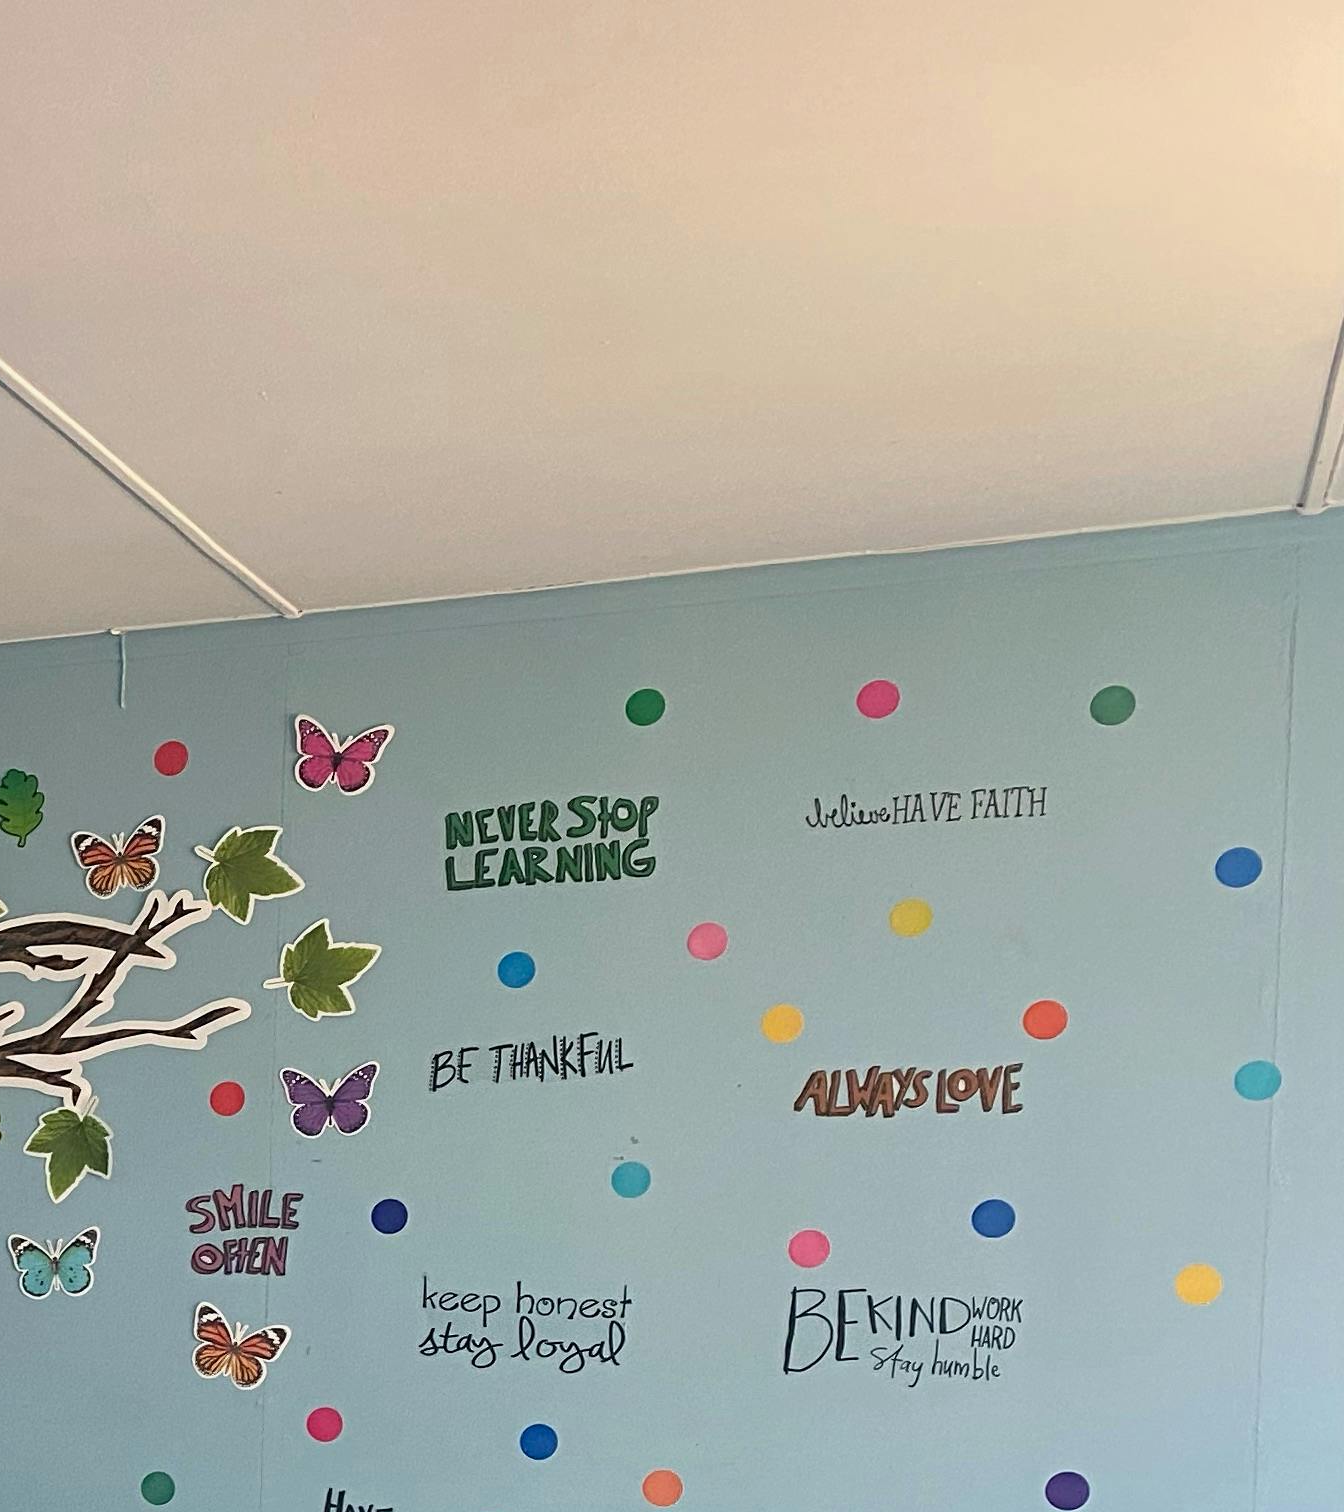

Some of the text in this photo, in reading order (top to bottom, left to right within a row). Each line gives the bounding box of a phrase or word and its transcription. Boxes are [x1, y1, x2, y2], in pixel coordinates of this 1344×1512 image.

[445, 795, 660, 850] NEVER STOP
[806, 786, 1048, 829] believe HAVE FAITH
[445, 838, 656, 891] LEARNING
[429, 1032, 634, 1092] BE THANKFUL
[794, 1062, 1024, 1118] ALWAYS LOVE
[185, 1183, 304, 1234] SMILE
[190, 1236, 289, 1277] OFTEN
[422, 1275, 633, 1328] keep honest
[418, 1315, 626, 1374] stay loyal
[783, 1286, 1024, 1375] BE KIND WORK
[970, 1325, 1016, 1350] HARD
[931, 1338, 1001, 1381] humble
